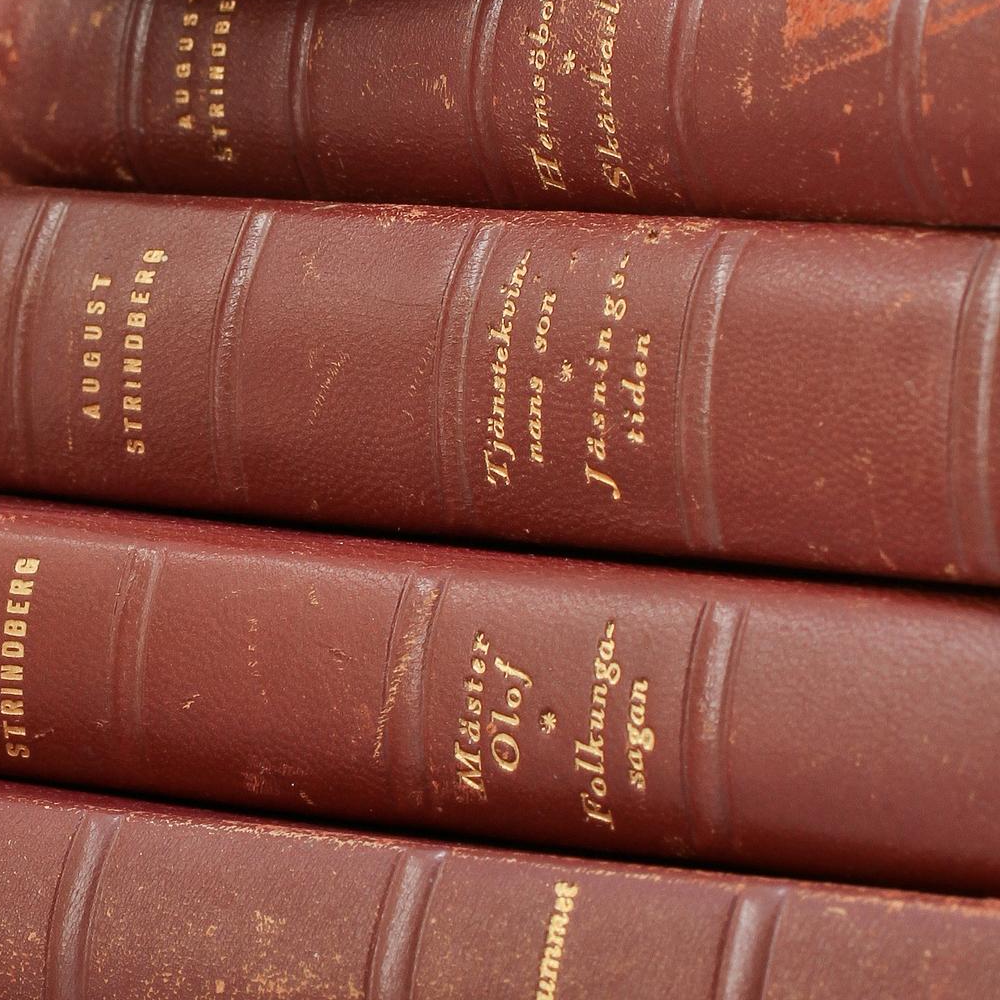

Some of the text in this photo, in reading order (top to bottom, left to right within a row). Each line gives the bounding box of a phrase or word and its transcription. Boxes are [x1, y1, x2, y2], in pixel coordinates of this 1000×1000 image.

[82, 273, 112, 419] AUGUST
[123, 249, 167, 454] STRINDBERG
[483, 249, 531, 486] Tjänstekvin-
[529, 290, 557, 465] nans son
[584, 253, 627, 500] Jäsnings-
[621, 333, 651, 443] tiden
[0, 557, 40, 758] STRINDBERG
[455, 631, 490, 800] Mäster
[491, 656, 533, 772] Olof
[574, 620, 621, 830] Folkunga-
[627, 679, 655, 792] sagan
